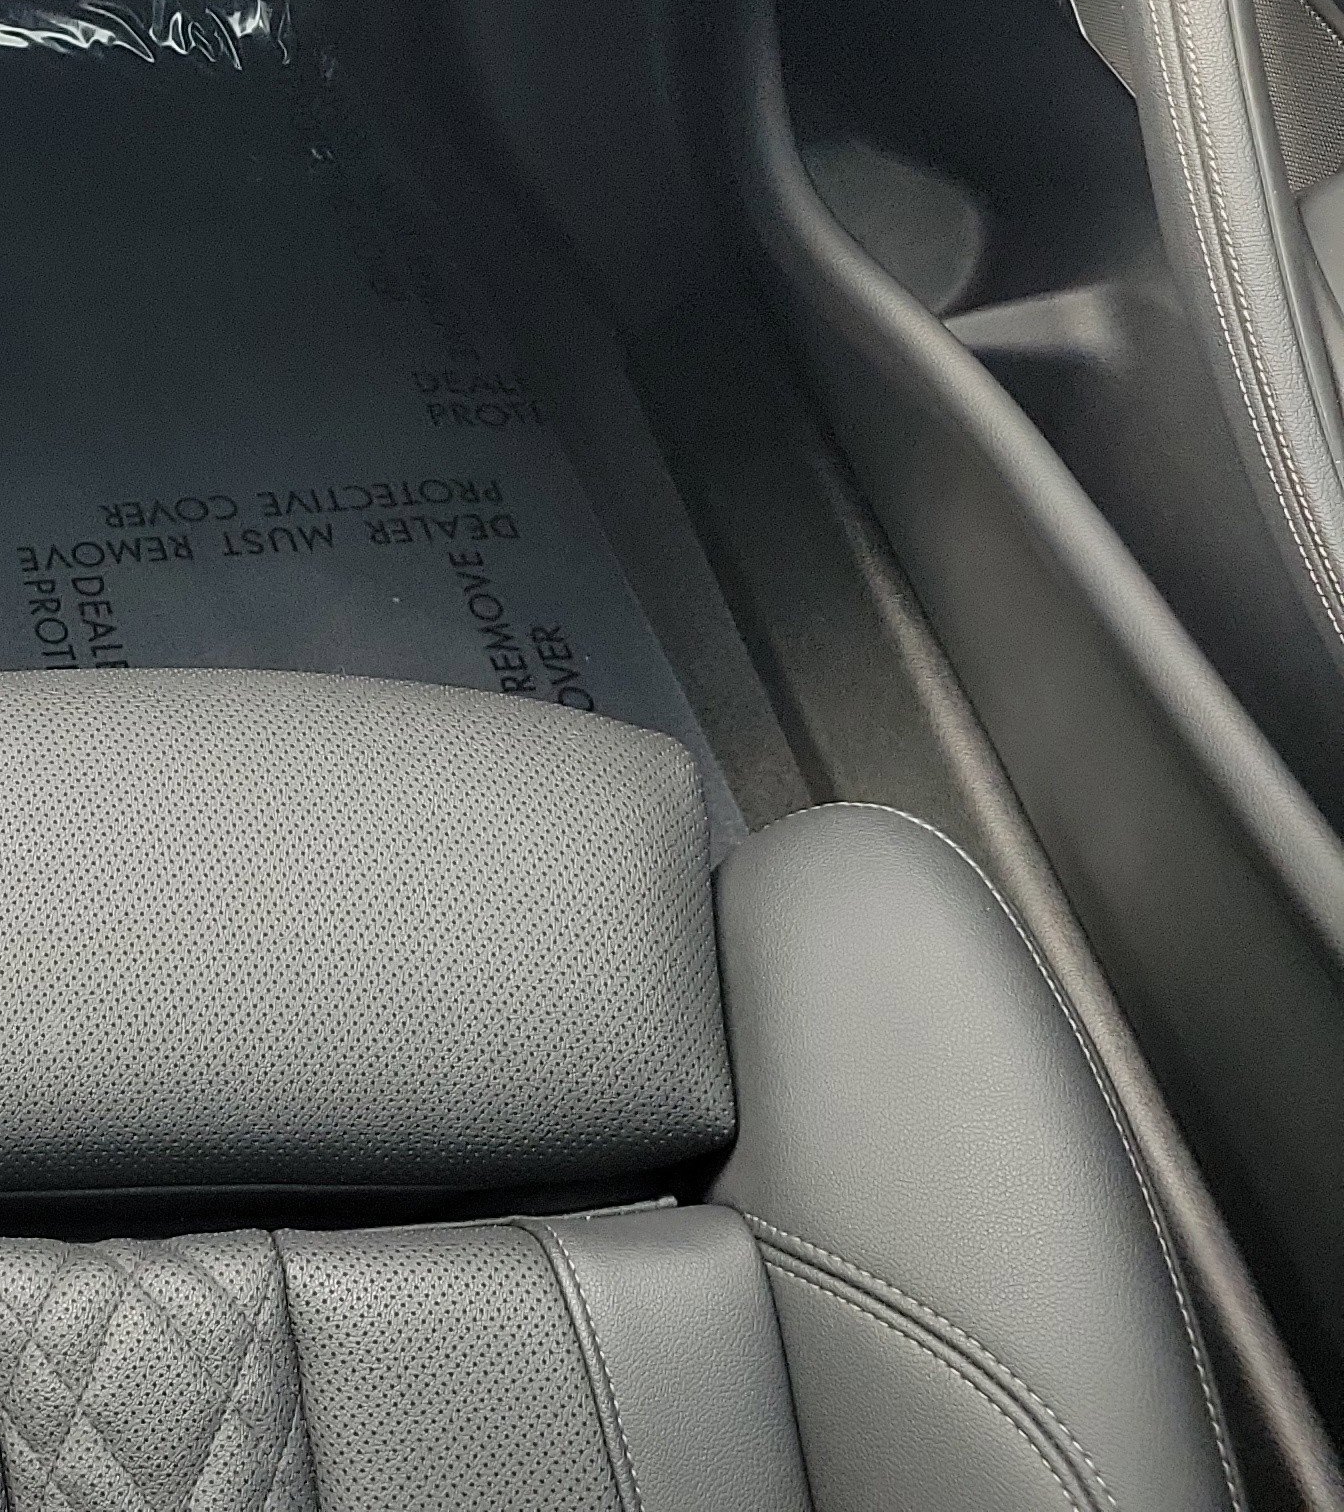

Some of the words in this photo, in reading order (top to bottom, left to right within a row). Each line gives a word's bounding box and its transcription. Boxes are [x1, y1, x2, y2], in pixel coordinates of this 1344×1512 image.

[96, 492, 241, 530] COVER
[256, 476, 505, 519] PROTECTIVE
[221, 521, 335, 558] MUST
[363, 512, 521, 546] DEALER
[14, 533, 196, 574] REMOVE
[446, 549, 539, 695] REMOVE
[528, 622, 599, 713] OVER
